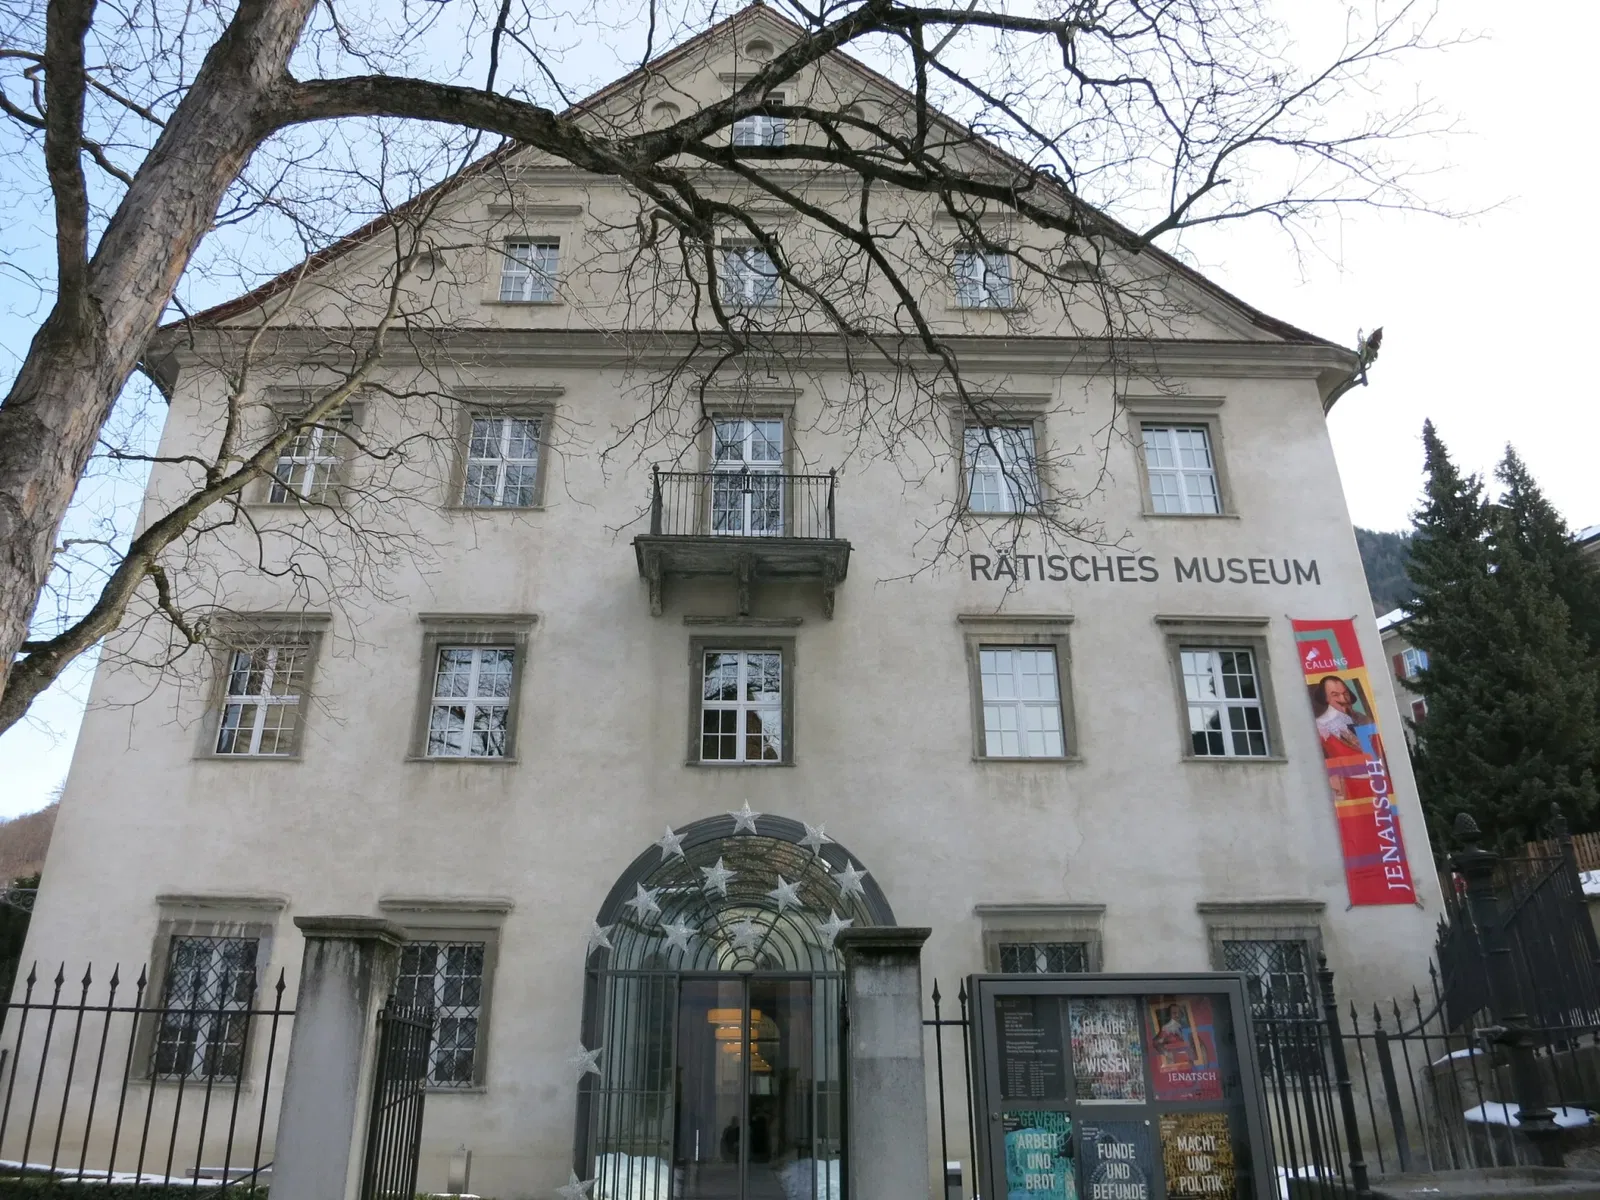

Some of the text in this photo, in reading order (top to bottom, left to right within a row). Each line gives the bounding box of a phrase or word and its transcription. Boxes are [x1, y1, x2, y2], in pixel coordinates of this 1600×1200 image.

[969, 549, 1321, 586] RÄTISCHES MUSEUM
[1305, 656, 1348, 670] CALLING
[1366, 758, 1411, 891] JENATSCH
[1083, 1019, 1126, 1035] GLAUBE
[1094, 1039, 1118, 1054] UND
[1086, 1057, 1130, 1073] WISSEN
[1168, 1072, 1217, 1083] JENATSCH
[1018, 1133, 1058, 1149] ARBEIT
[1177, 1135, 1216, 1152] MACHT
[1097, 1143, 1136, 1159] FUNDE
[1027, 1153, 1051, 1169] UND
[1187, 1155, 1211, 1172] UND
[1106, 1163, 1130, 1179] UND
[1025, 1173, 1056, 1190] BROT
[1179, 1175, 1225, 1193] POLITIK
[1093, 1183, 1147, 1200] BEFUNDE
